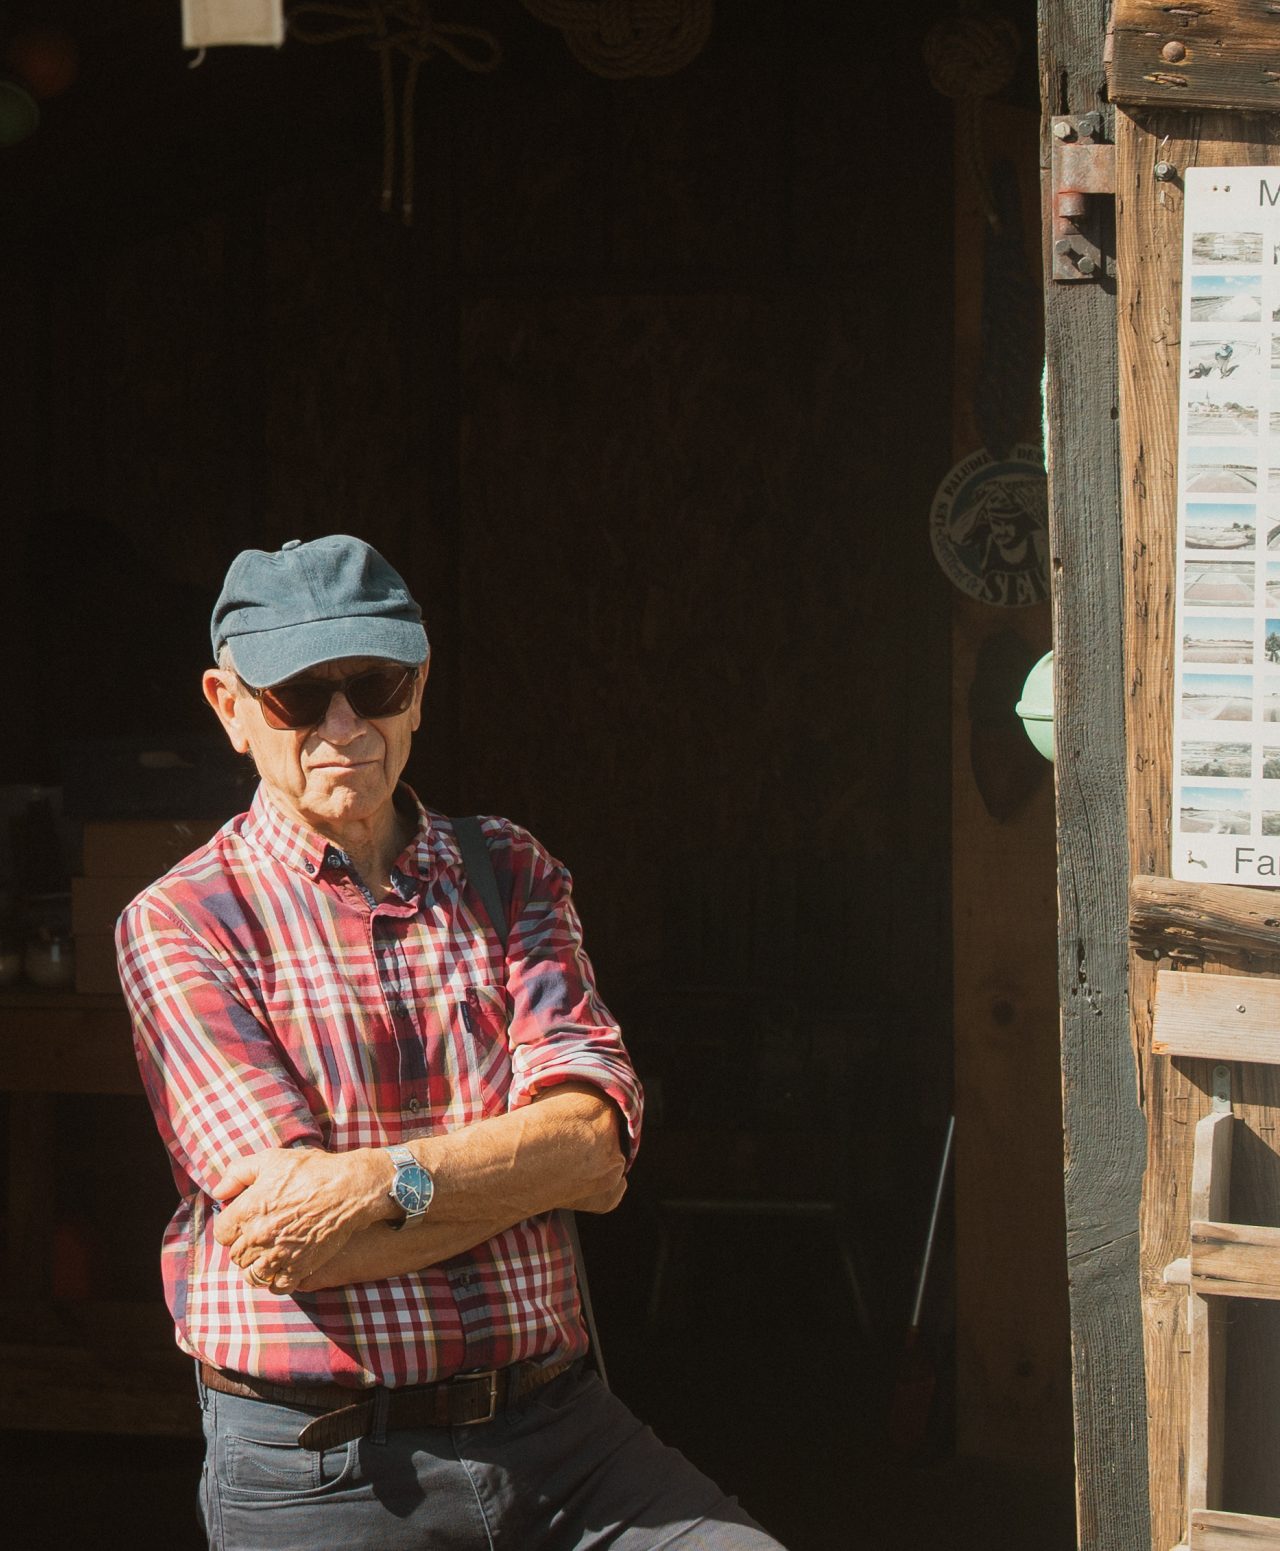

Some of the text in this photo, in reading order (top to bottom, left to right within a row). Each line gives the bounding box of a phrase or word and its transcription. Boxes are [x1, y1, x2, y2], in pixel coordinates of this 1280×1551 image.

[1260, 179, 1280, 206] M
[943, 453, 990, 496] PALUDIE
[1235, 847, 1280, 876] Fa
